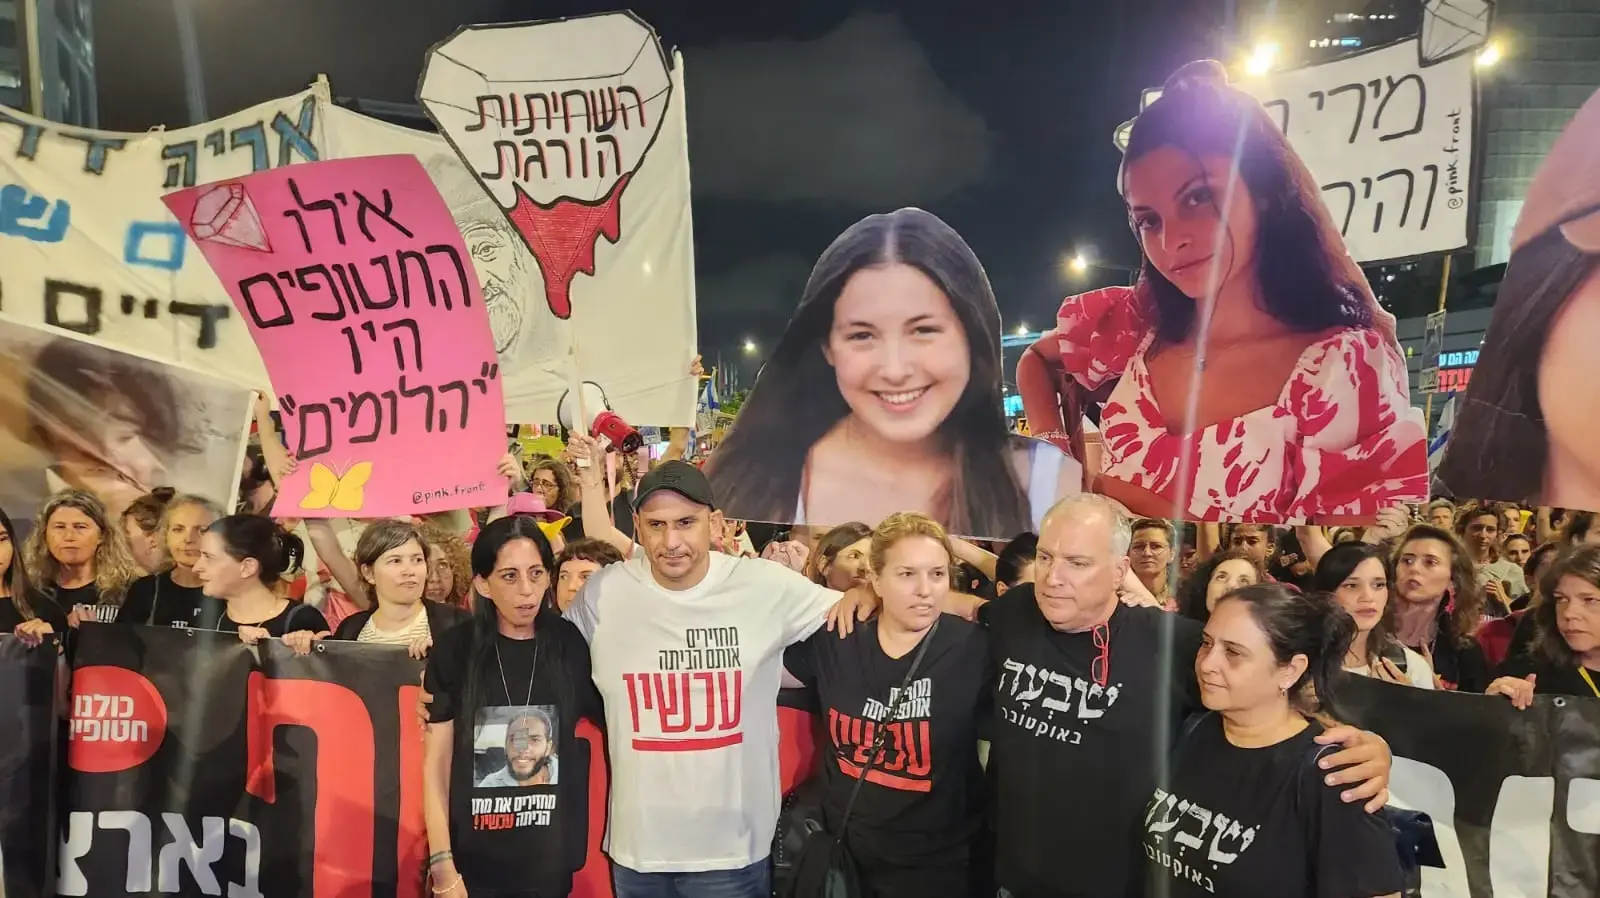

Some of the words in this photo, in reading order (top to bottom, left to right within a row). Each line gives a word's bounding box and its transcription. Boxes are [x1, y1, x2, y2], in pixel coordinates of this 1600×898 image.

[464, 86, 646, 136] השחיתות
[1308, 73, 1426, 144] מירי
[480, 134, 622, 182] הורגת
[283, 177, 414, 254] אילו
[239, 244, 471, 328] החטופים
[341, 318, 422, 375] היו
[686, 626, 739, 648] מחזירים
[658, 650, 702, 670] הביתה
[706, 648, 741, 669] אותם
[74, 694, 134, 718] כולנו
[622, 670, 741, 732] עכשיו
[1001, 706, 1082, 745] באוקטובר
[471, 798, 493, 815] מתן
[494, 797, 512, 813] את
[513, 794, 556, 812] מחזירים
[516, 811, 551, 827] הביתה
